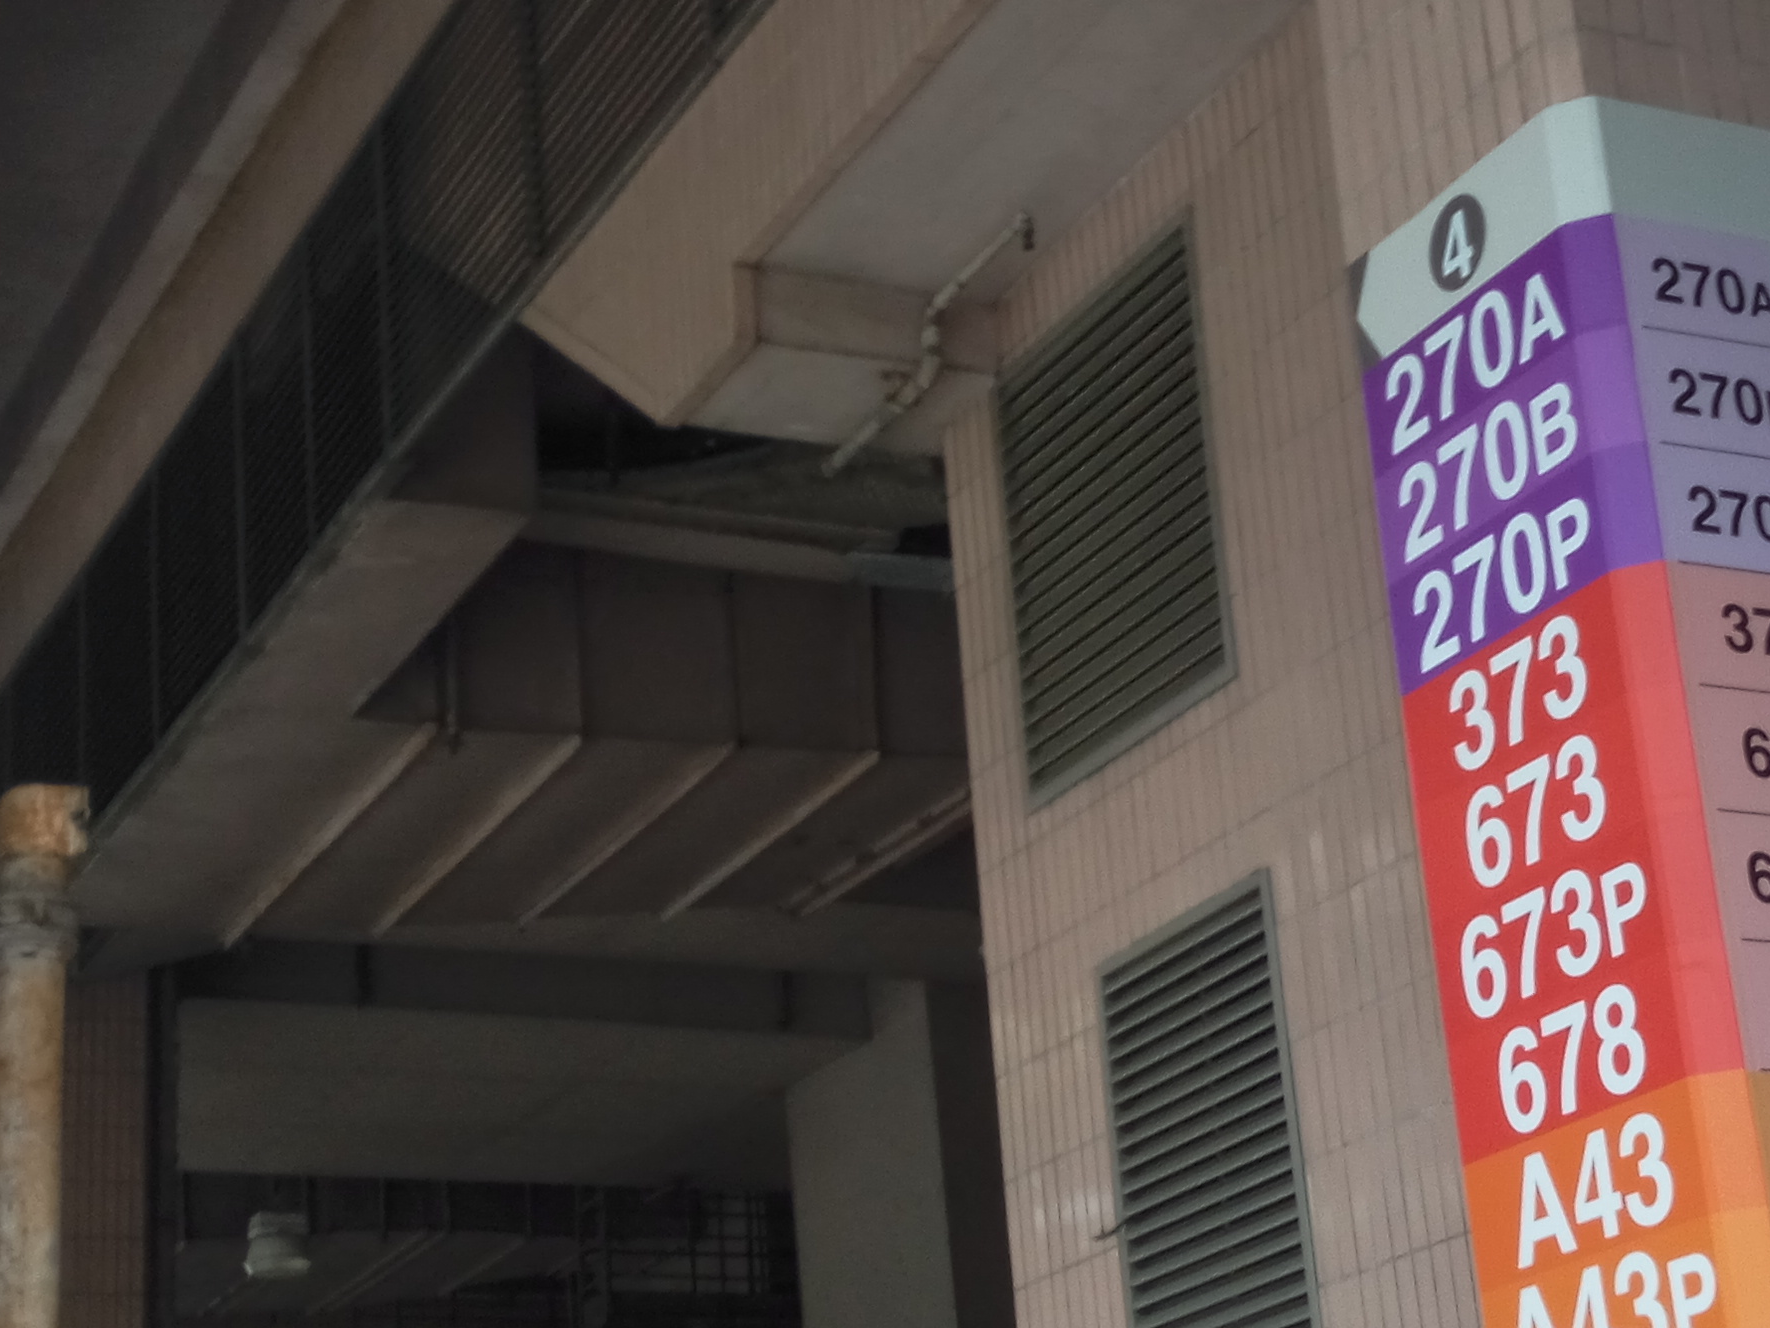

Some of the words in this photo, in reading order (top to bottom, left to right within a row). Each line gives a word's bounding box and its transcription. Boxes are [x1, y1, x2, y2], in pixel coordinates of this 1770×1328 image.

[1440, 213, 1477, 280] 4
[1385, 272, 1565, 457] 270A
[1398, 381, 1578, 563] 270B
[1413, 498, 1589, 674] 270P
[1448, 615, 1588, 772] 373
[1465, 733, 1607, 889] 673
[1459, 862, 1647, 1019] 673P
[1497, 984, 1646, 1135] 678
[1516, 1113, 1674, 1269] A43
